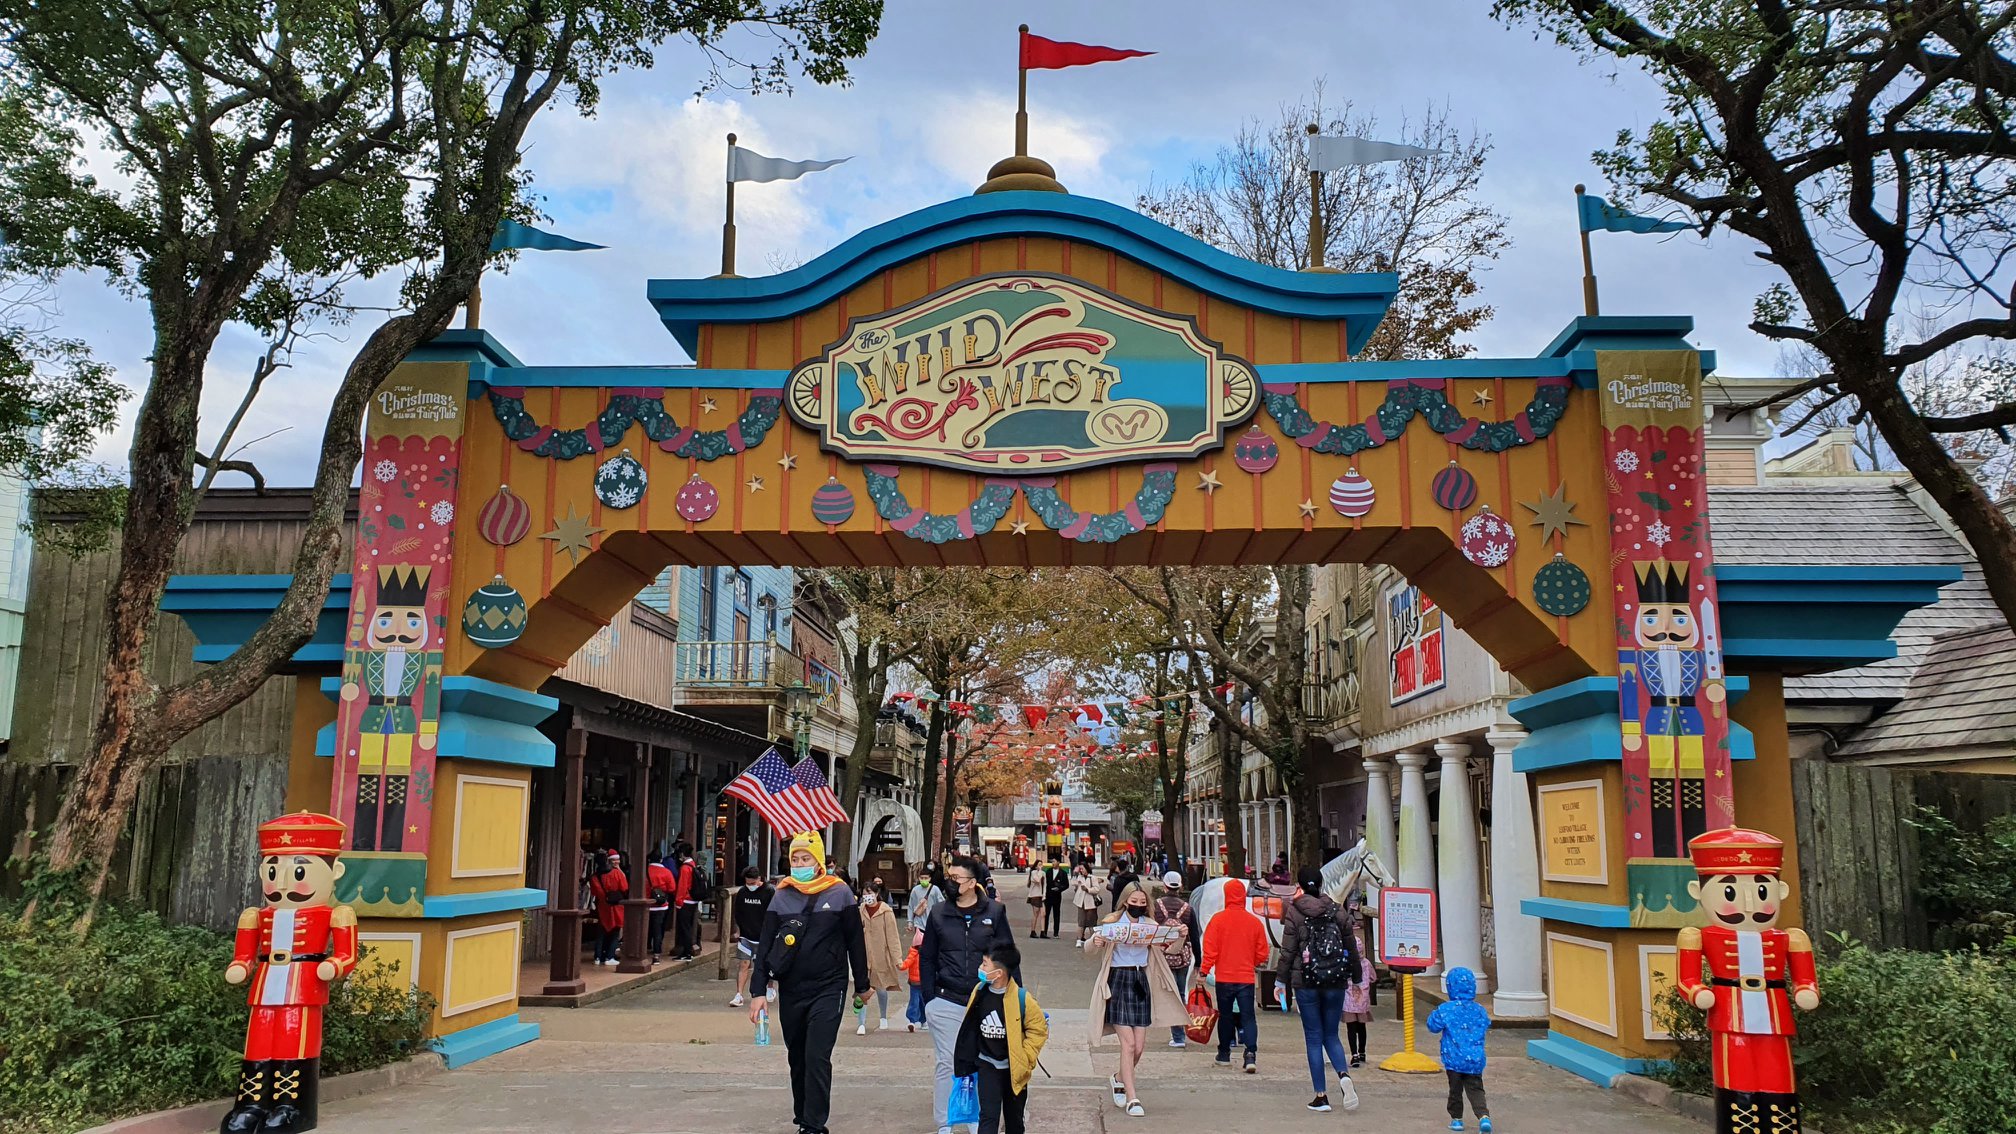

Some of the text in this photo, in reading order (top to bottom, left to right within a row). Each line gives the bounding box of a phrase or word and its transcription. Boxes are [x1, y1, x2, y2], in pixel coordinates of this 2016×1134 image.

[858, 328, 888, 351] The
[855, 314, 1002, 409] WILD
[964, 358, 1115, 437] WEST
[1608, 378, 1680, 404] Christmas
[378, 389, 447, 415] Christmas
[1650, 395, 1673, 411] Fairy
[1672, 395, 1691, 408] Tale
[417, 406, 439, 422] Fairy
[439, 407, 456, 420] Tale
[1562, 802, 1580, 811] WELCOME
[1569, 814, 1575, 822] TO
[980, 1024, 1006, 1036] adidas
